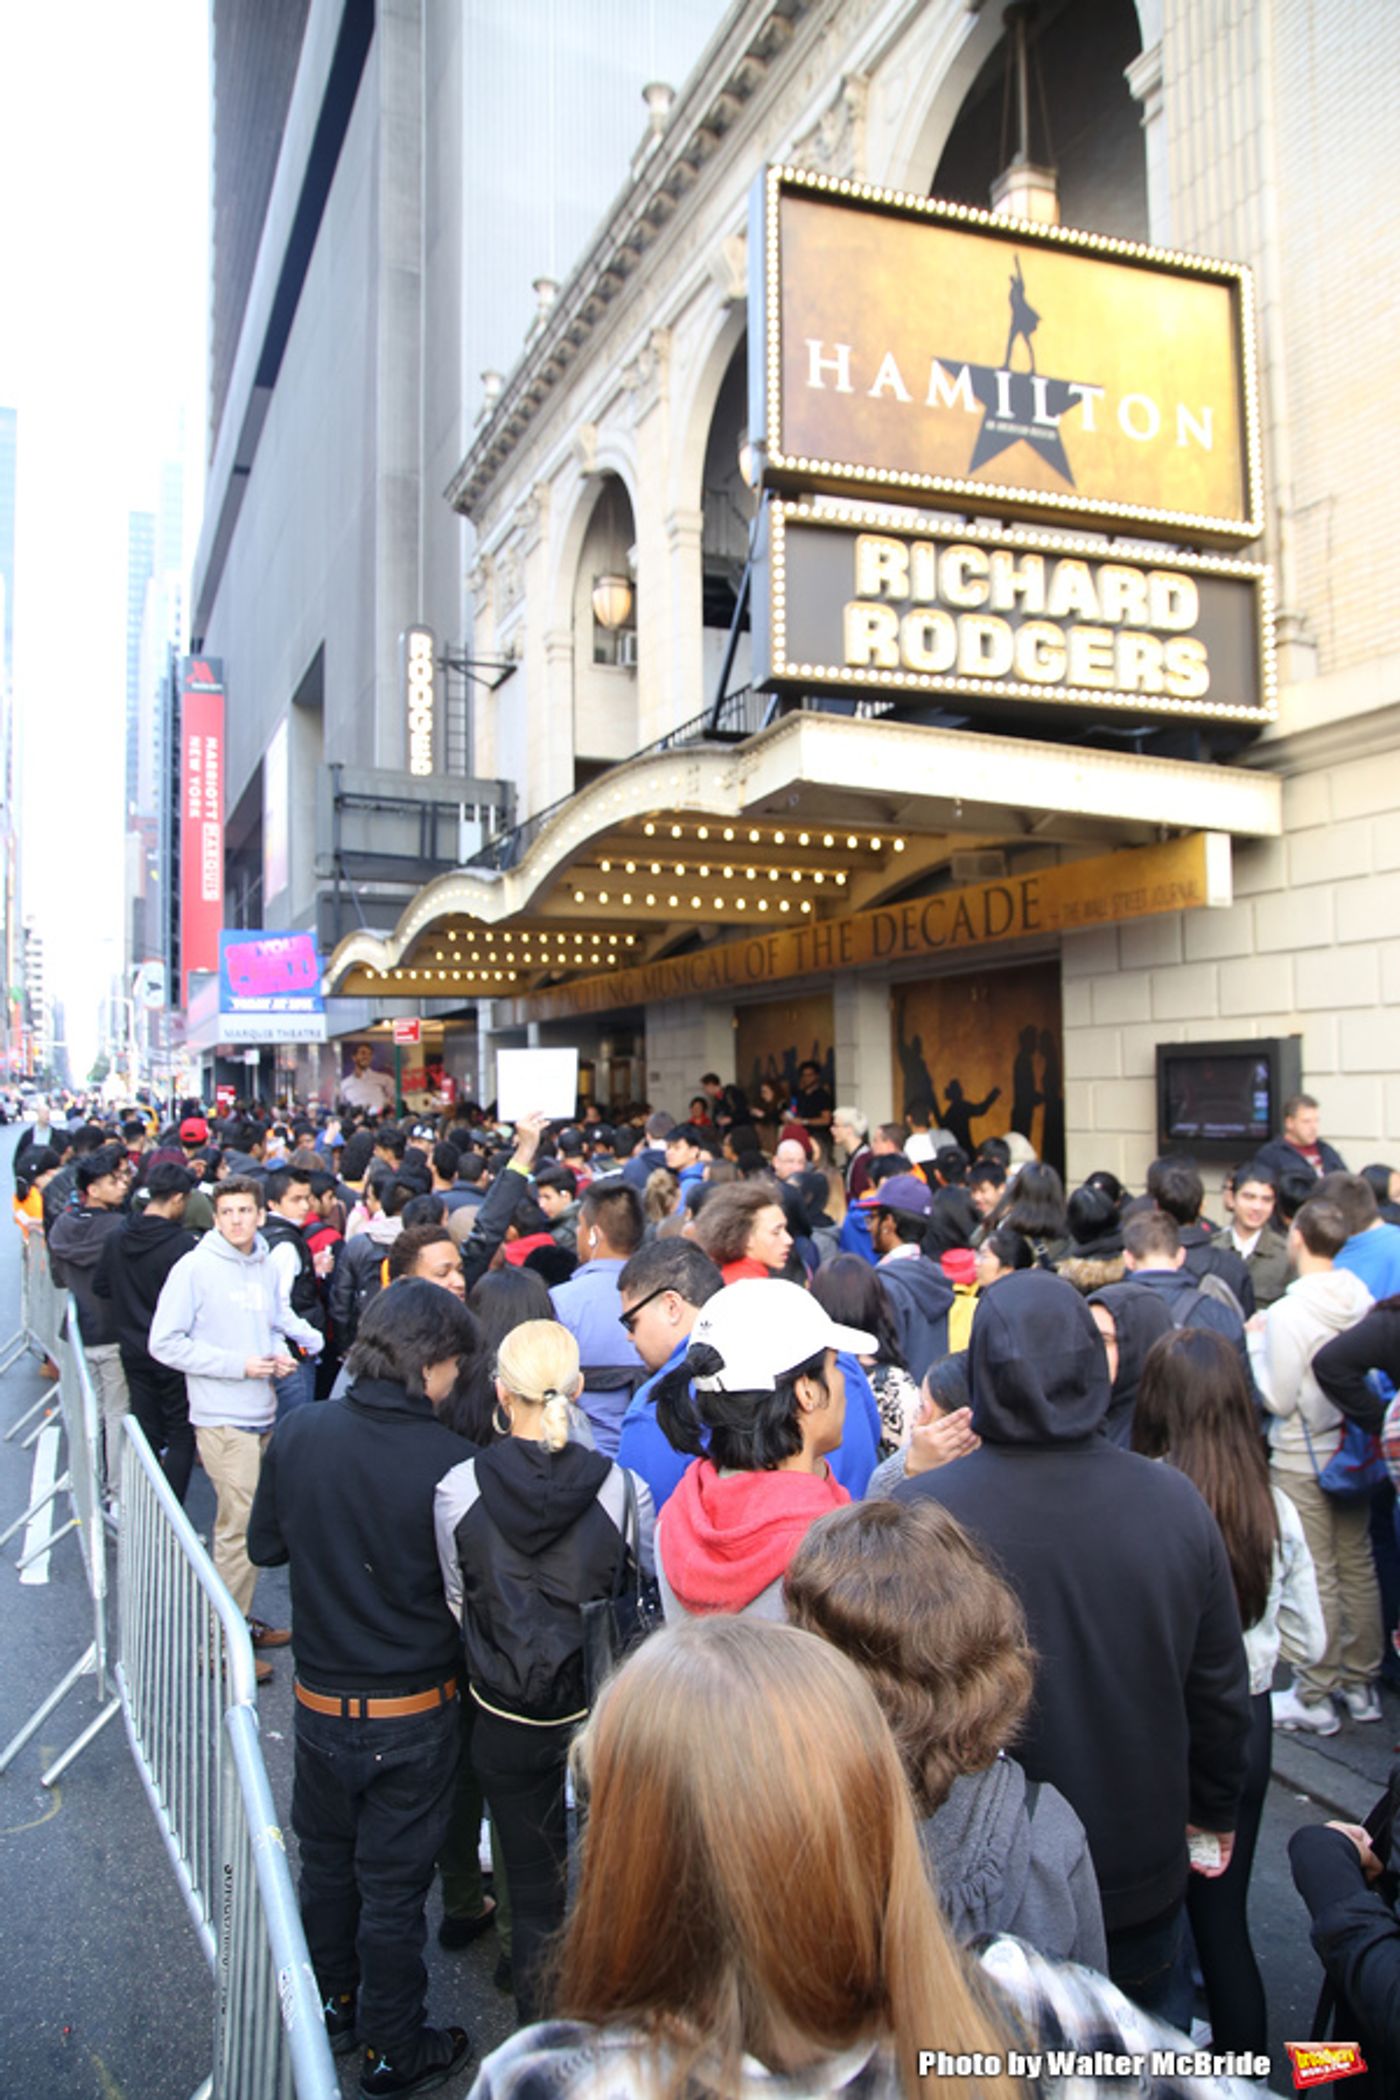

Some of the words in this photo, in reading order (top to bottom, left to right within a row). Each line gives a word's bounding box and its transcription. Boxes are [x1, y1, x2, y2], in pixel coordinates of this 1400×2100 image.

[804, 338, 1214, 451] HAMILTON
[853, 533, 1200, 632] RICHARD
[842, 600, 1211, 698] RODGERS
[744, 940, 780, 979] OF
[792, 920, 852, 971] THE
[871, 878, 1042, 957] DECADE
